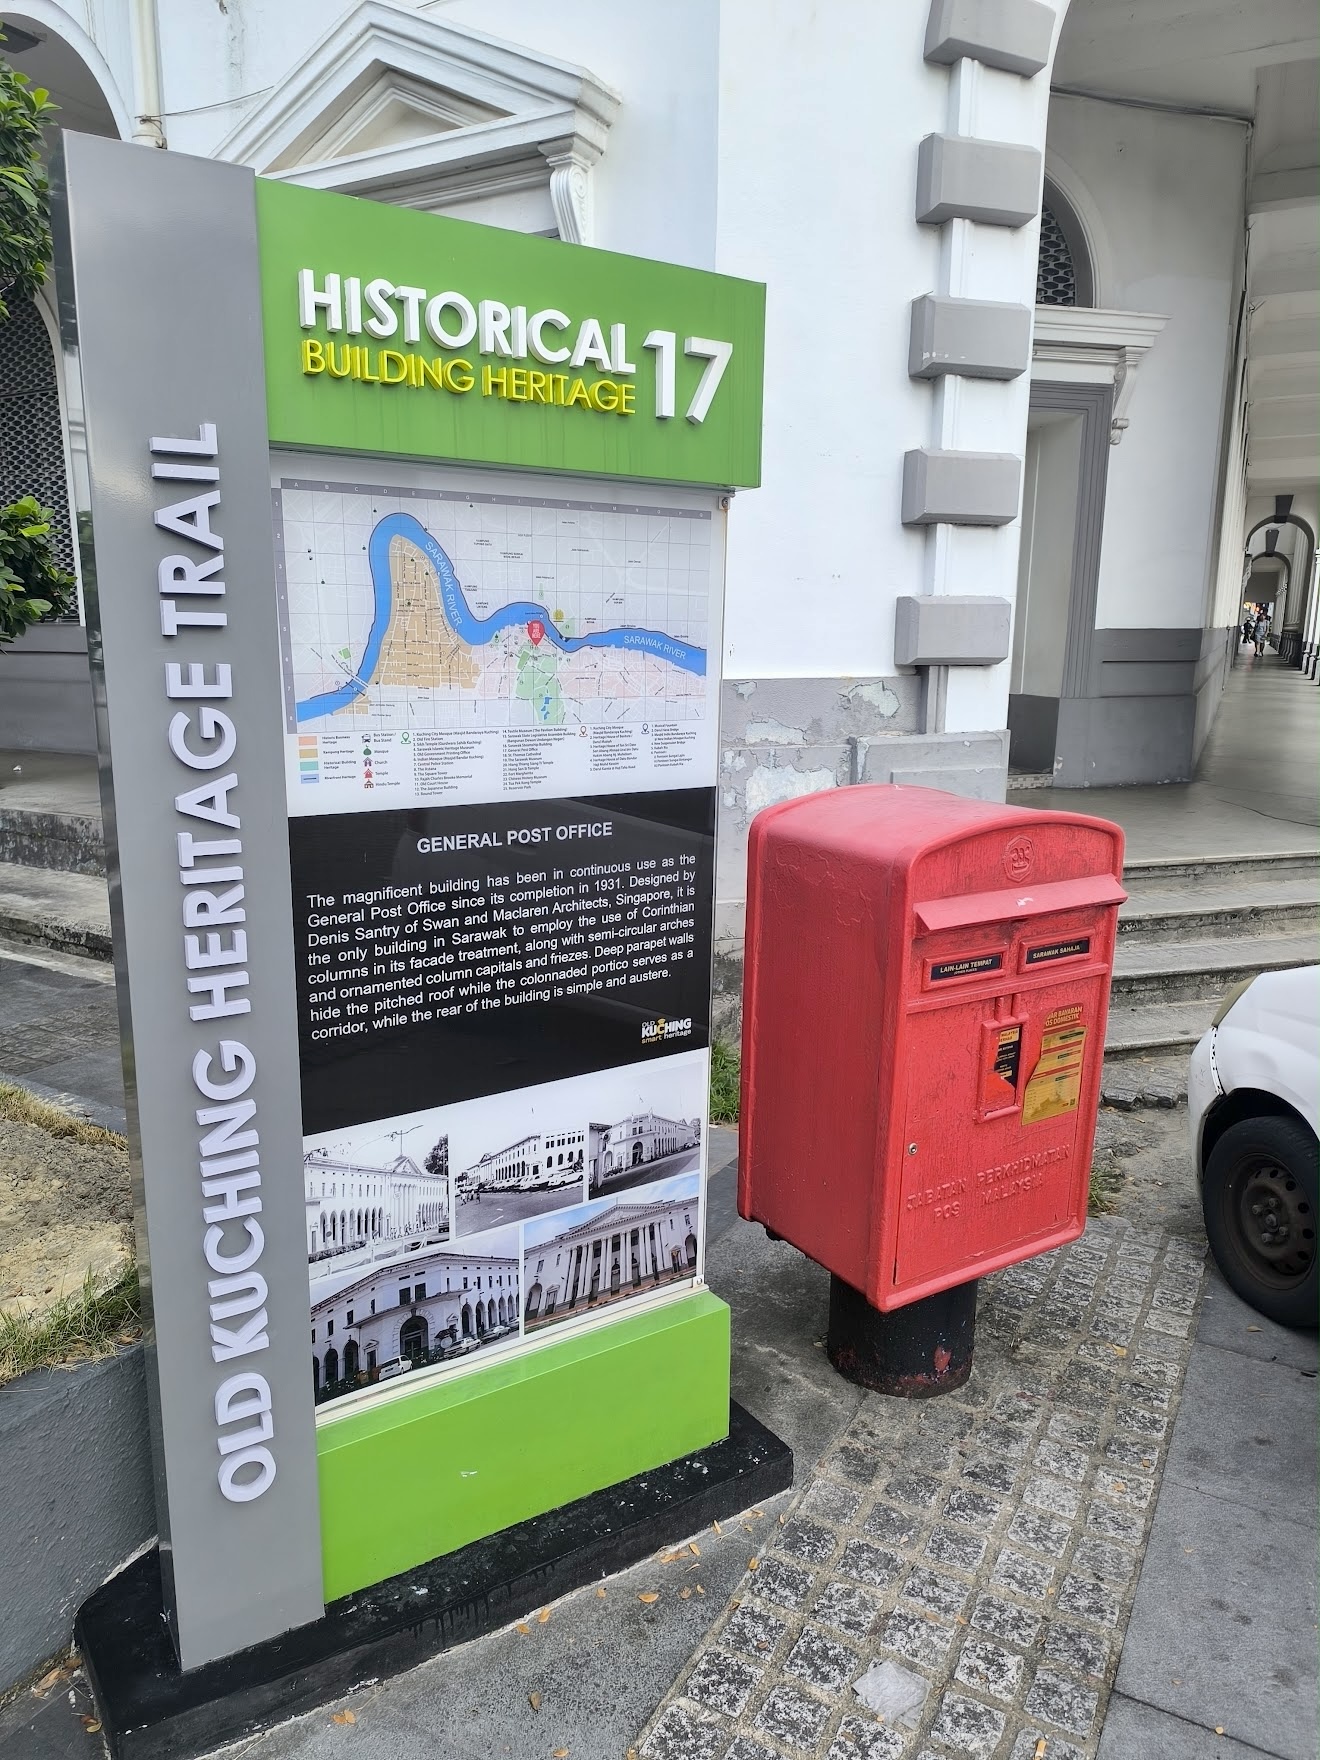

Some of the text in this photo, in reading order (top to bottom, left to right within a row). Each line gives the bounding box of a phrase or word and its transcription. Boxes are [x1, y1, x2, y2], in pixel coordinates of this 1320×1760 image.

[298, 268, 732, 424] HISTORICAL 17
[302, 339, 636, 416] BUILDING HERITAGE
[425, 542, 462, 626] SARAWAK RIVER
[624, 636, 686, 659] SARAWAK RIVER
[416, 822, 612, 854] GENERAL POST OFFICE
[306, 854, 695, 907] The magnificent building has been in continuous use as the
[308, 870, 695, 927] General Post Office since its completion in 1931. Designed by
[308, 885, 694, 946] Denis Santry of Swan and Maclaren Architects, Singapore, it is
[308, 902, 694, 965] the only building in Sarawak to employ the use of Corinthian
[149, 422, 277, 1503] OLD KUCHING HERITAGE TRAIL
[308, 918, 694, 984] columns in its facade treatment, along with semi-circular arches
[309, 932, 694, 1002] and ornamented column capitals and friezes. Deep parapet walls
[940, 962, 969, 973] LAIN-LAIN
[970, 958, 993, 968] TEMPAT
[1032, 944, 1080, 959] SARAWAK SAHAJA
[310, 950, 693, 1021] hide the pitched roof while the colonnaded portico serves as a
[311, 969, 670, 1039] corridor, while the rear of the building is simple and austere.
[642, 1018, 691, 1038] KUCHING
[642, 1030, 691, 1044] smart heritage
[907, 1144, 1070, 1210] JABATAN PERKHIDMATAN
[934, 1173, 1043, 1223] POS MALAYSIA
